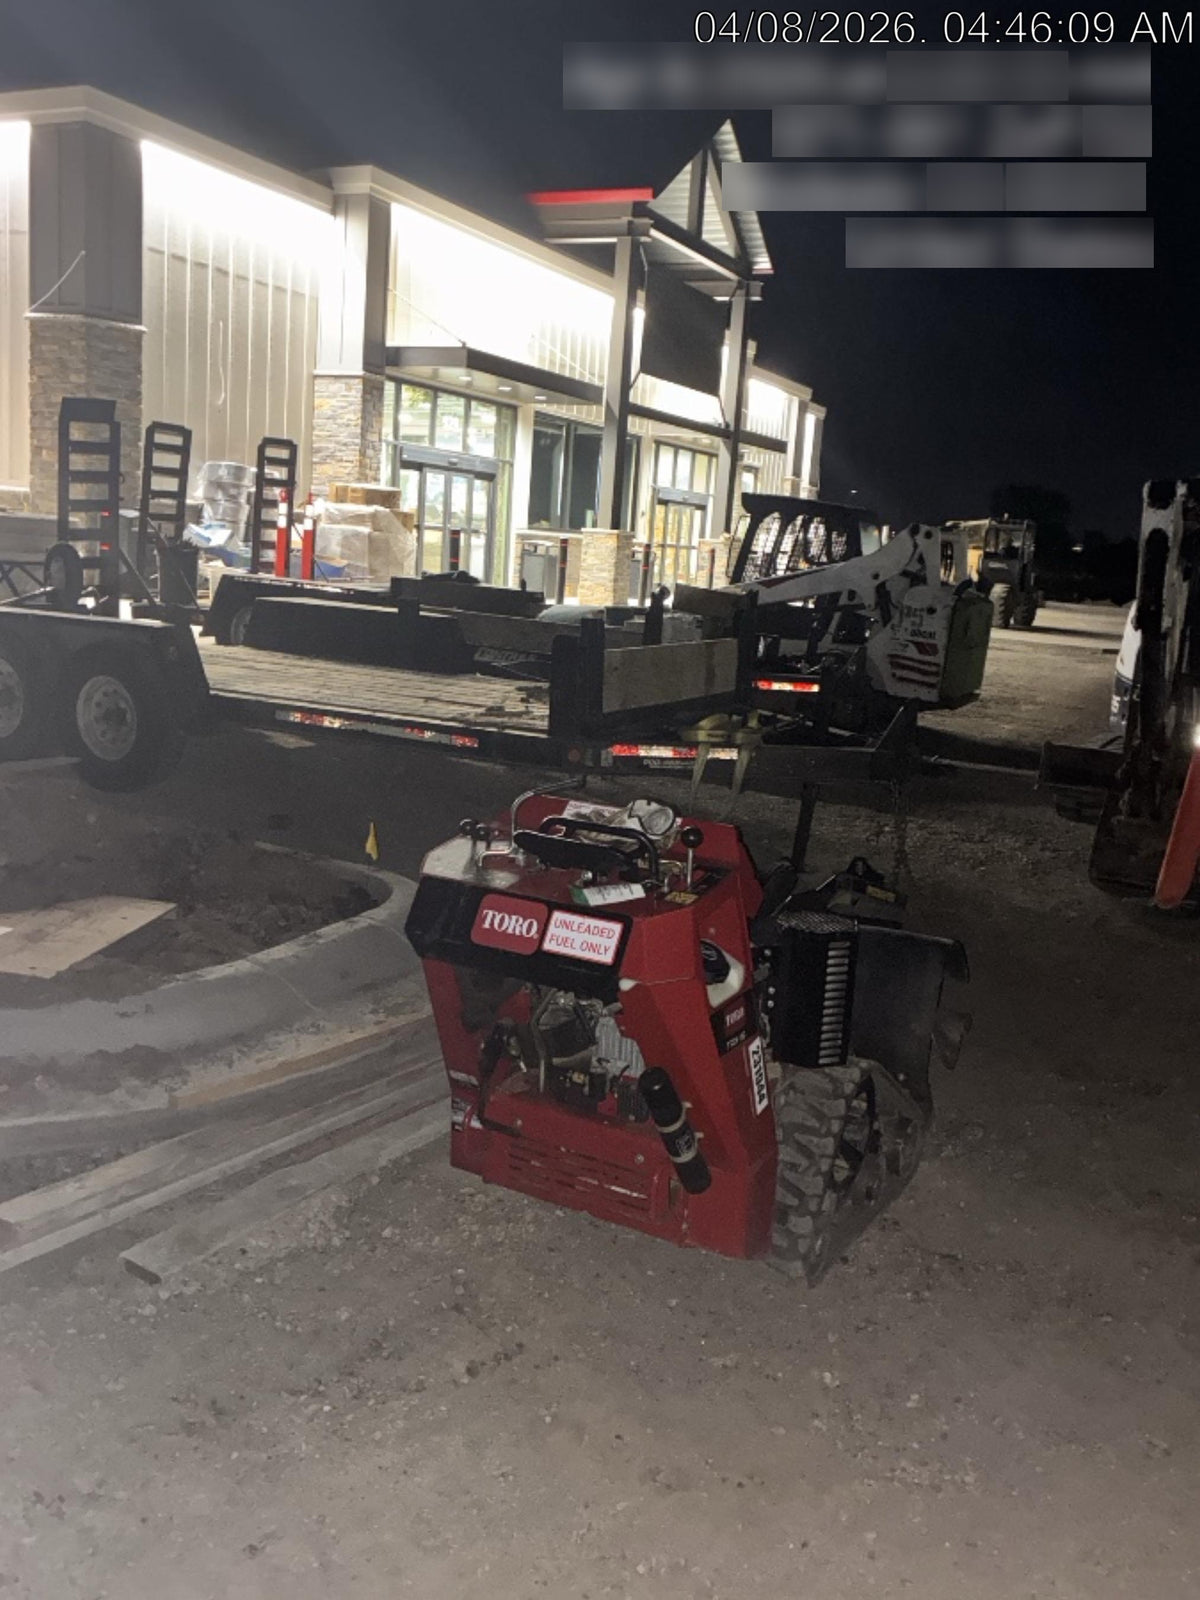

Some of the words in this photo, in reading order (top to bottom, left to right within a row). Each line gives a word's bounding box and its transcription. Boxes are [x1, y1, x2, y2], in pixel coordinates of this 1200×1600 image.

[482, 909, 539, 938] TORO
[554, 918, 616, 940] UNLEADED
[549, 933, 577, 950] FUEL
[579, 940, 611, 956] ONLY
